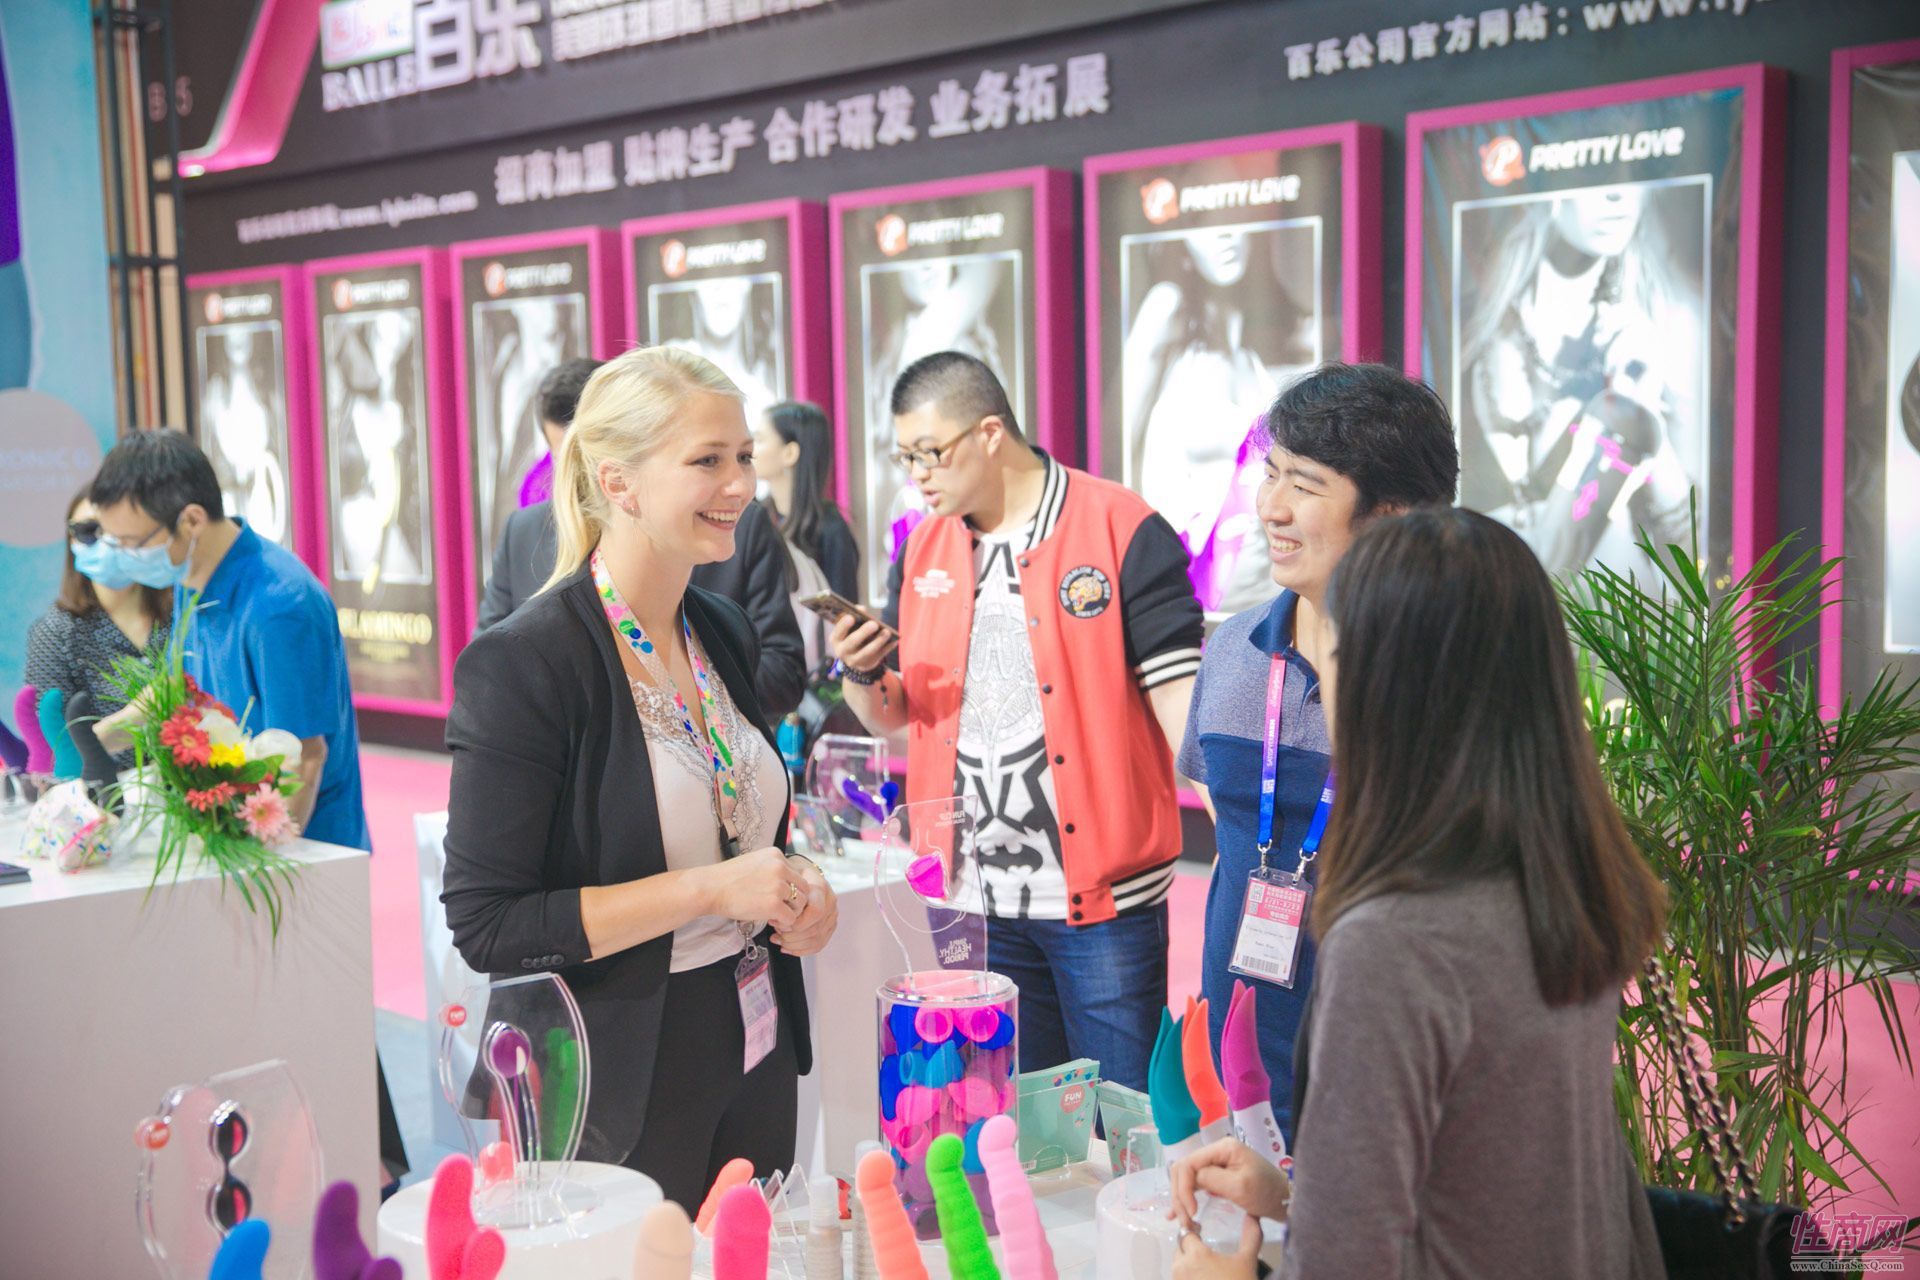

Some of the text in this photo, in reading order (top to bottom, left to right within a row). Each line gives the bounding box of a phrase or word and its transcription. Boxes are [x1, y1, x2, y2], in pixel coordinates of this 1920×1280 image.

[928, 51, 1109, 138] 业务拓展
[1064, 1090, 1082, 1102] FUN
